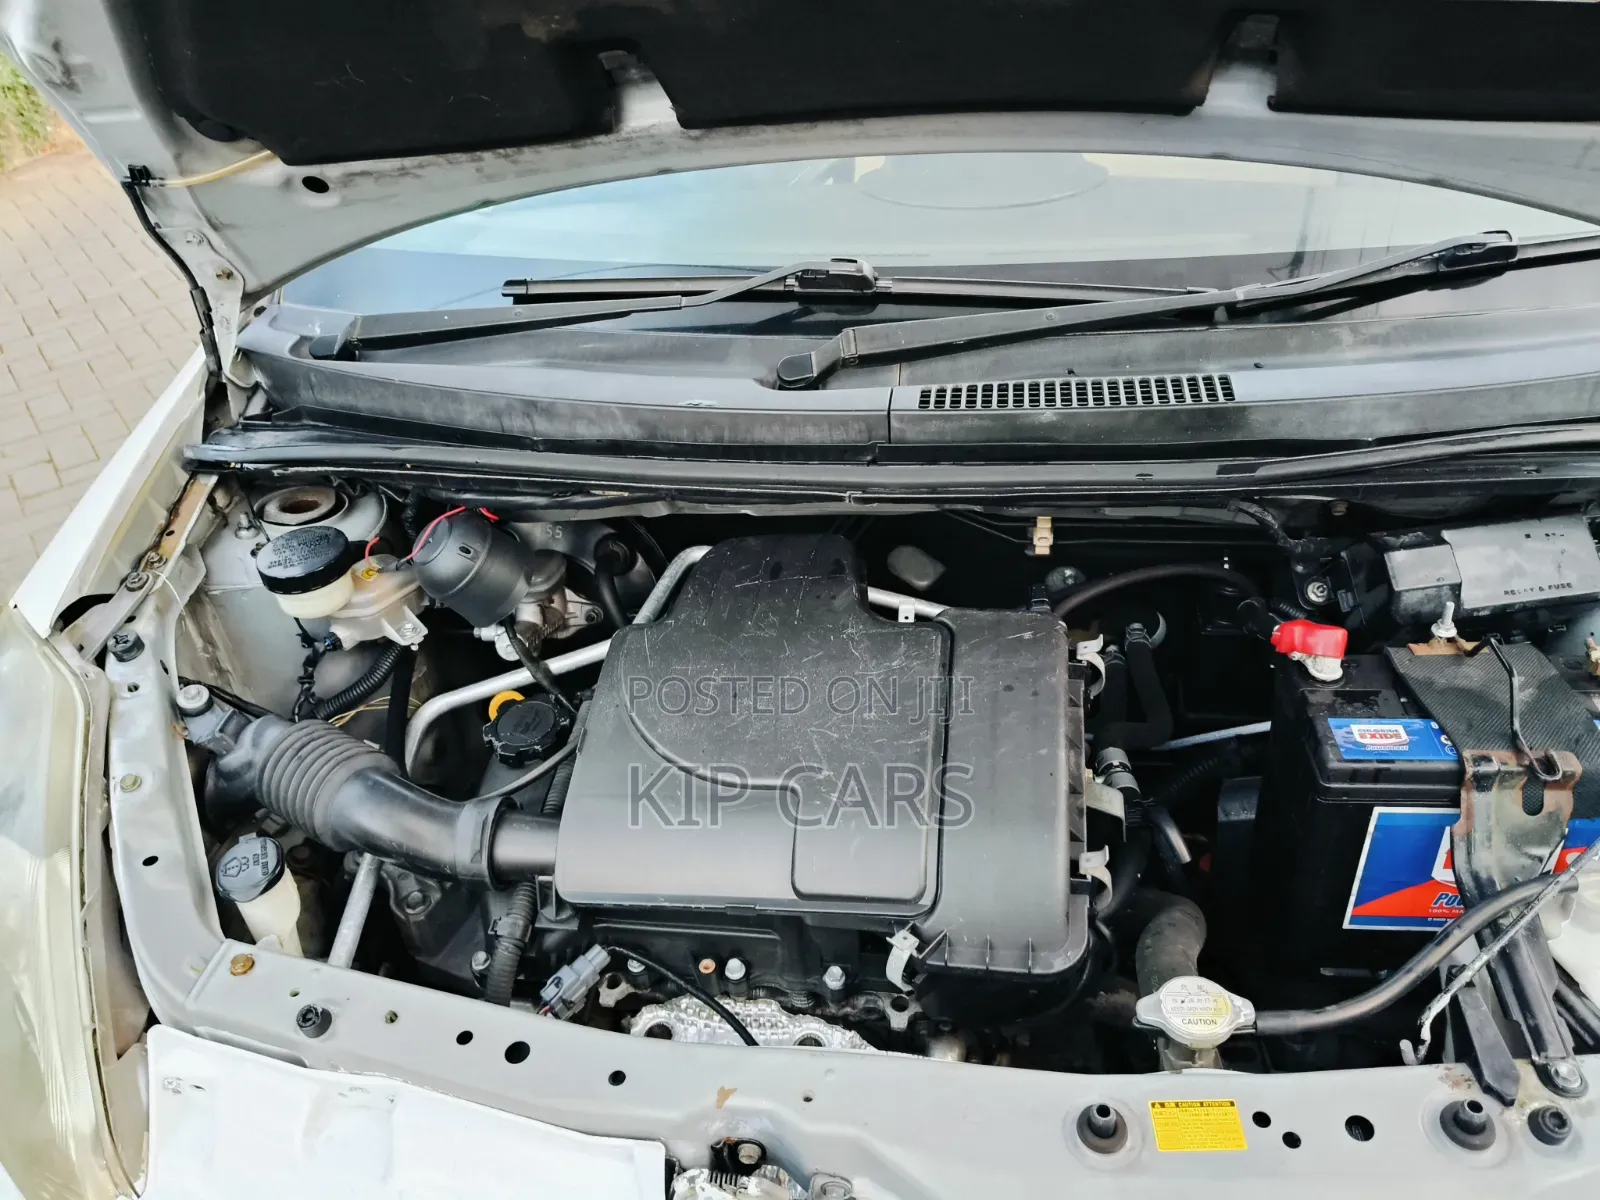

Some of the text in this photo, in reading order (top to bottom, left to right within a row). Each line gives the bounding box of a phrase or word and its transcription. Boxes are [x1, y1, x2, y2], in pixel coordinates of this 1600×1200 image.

[1503, 587, 1535, 596] RELAY
[1547, 582, 1573, 591] FUSE
[1181, 1018, 1218, 1026] CAUTION
